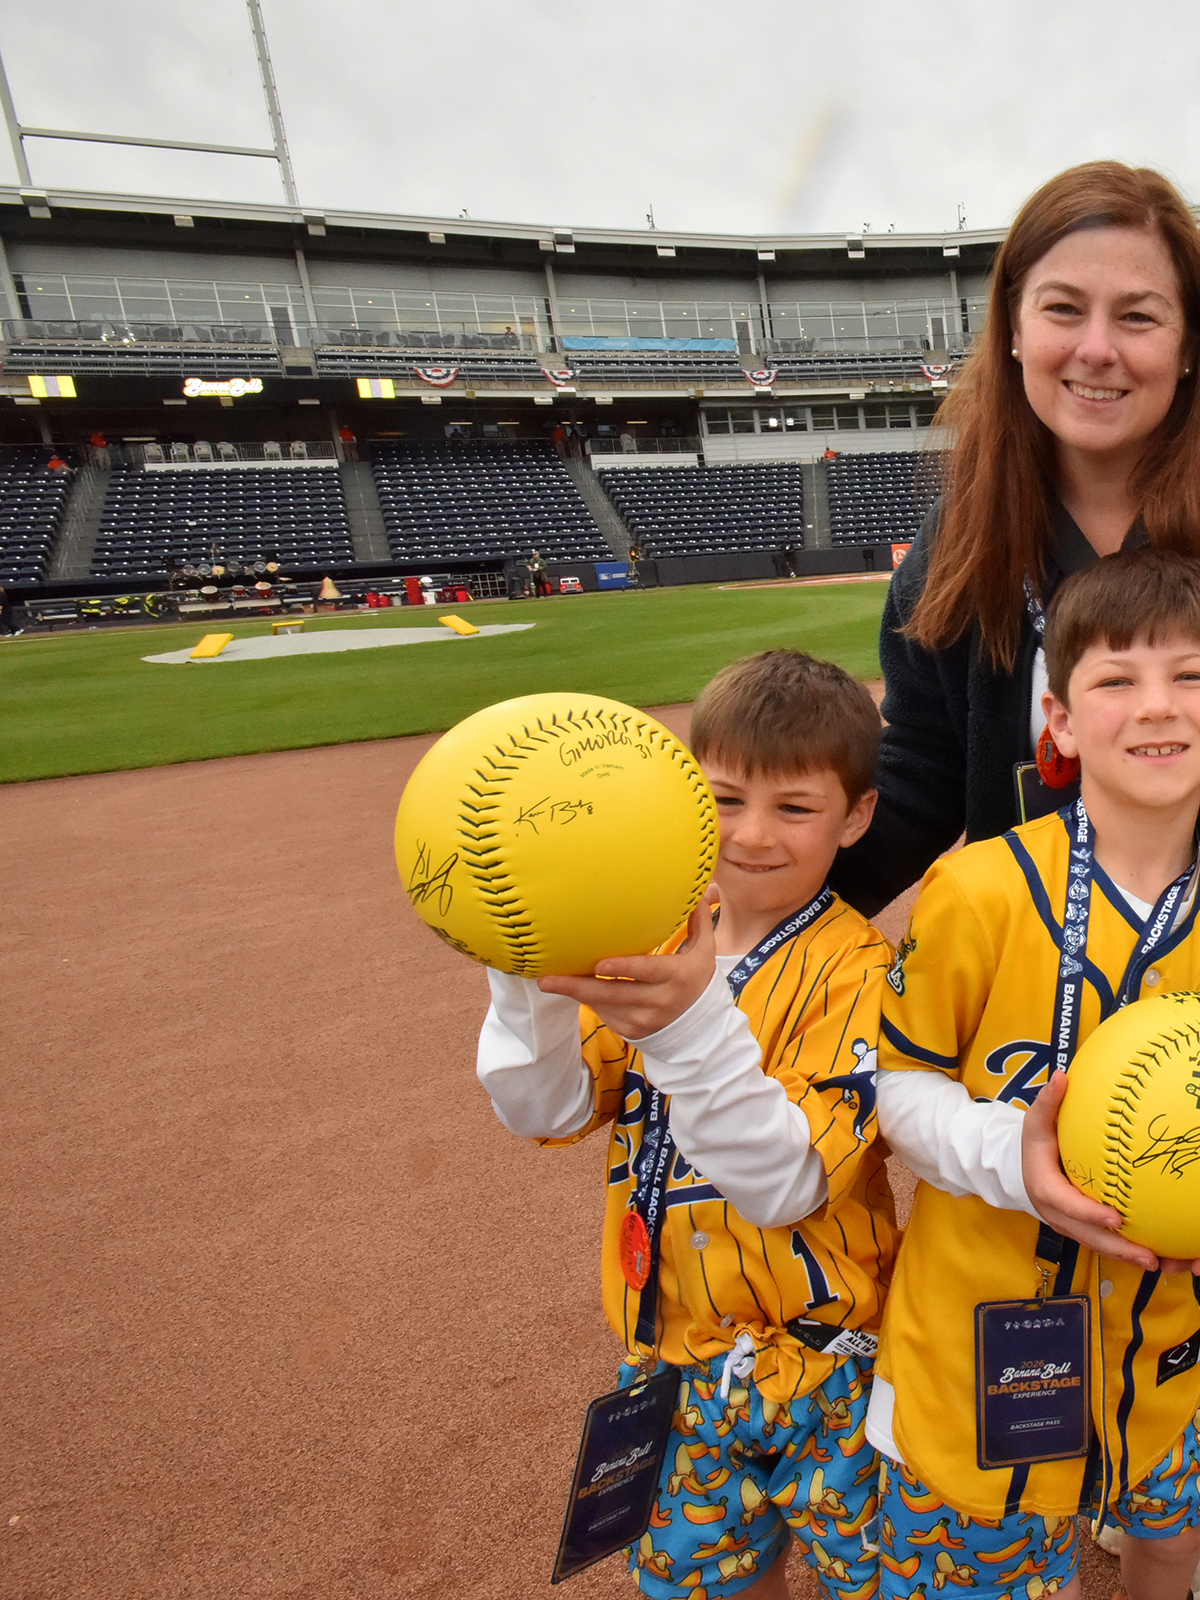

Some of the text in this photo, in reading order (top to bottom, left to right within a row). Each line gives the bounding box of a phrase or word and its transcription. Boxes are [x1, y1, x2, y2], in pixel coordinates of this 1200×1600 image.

[1076, 797, 1088, 843] CKSTAGE
[758, 900, 821, 955] BACKSTAGE
[1140, 885, 1181, 955] BACKSTAGE
[1056, 983, 1075, 1072] BANANA BA
[650, 1090, 660, 1121] BAN
[653, 1149, 669, 1185] BALL
[790, 1228, 841, 1311] 1
[845, 1337, 861, 1348] ALL
[1000, 1361, 1072, 1384] Banana Ball
[1020, 1360, 1045, 1370] 2026
[987, 1376, 1081, 1395] BACKSTAGE
[1013, 1389, 1057, 1400] EXPERIENCE
[1010, 1419, 1061, 1430] BACKSTAGE PASS
[577, 1454, 658, 1500] BACKSTAGE
[591, 1456, 628, 1483] Banana
[626, 1441, 653, 1466] Ball
[598, 1474, 636, 1497] EXPERIENCE
